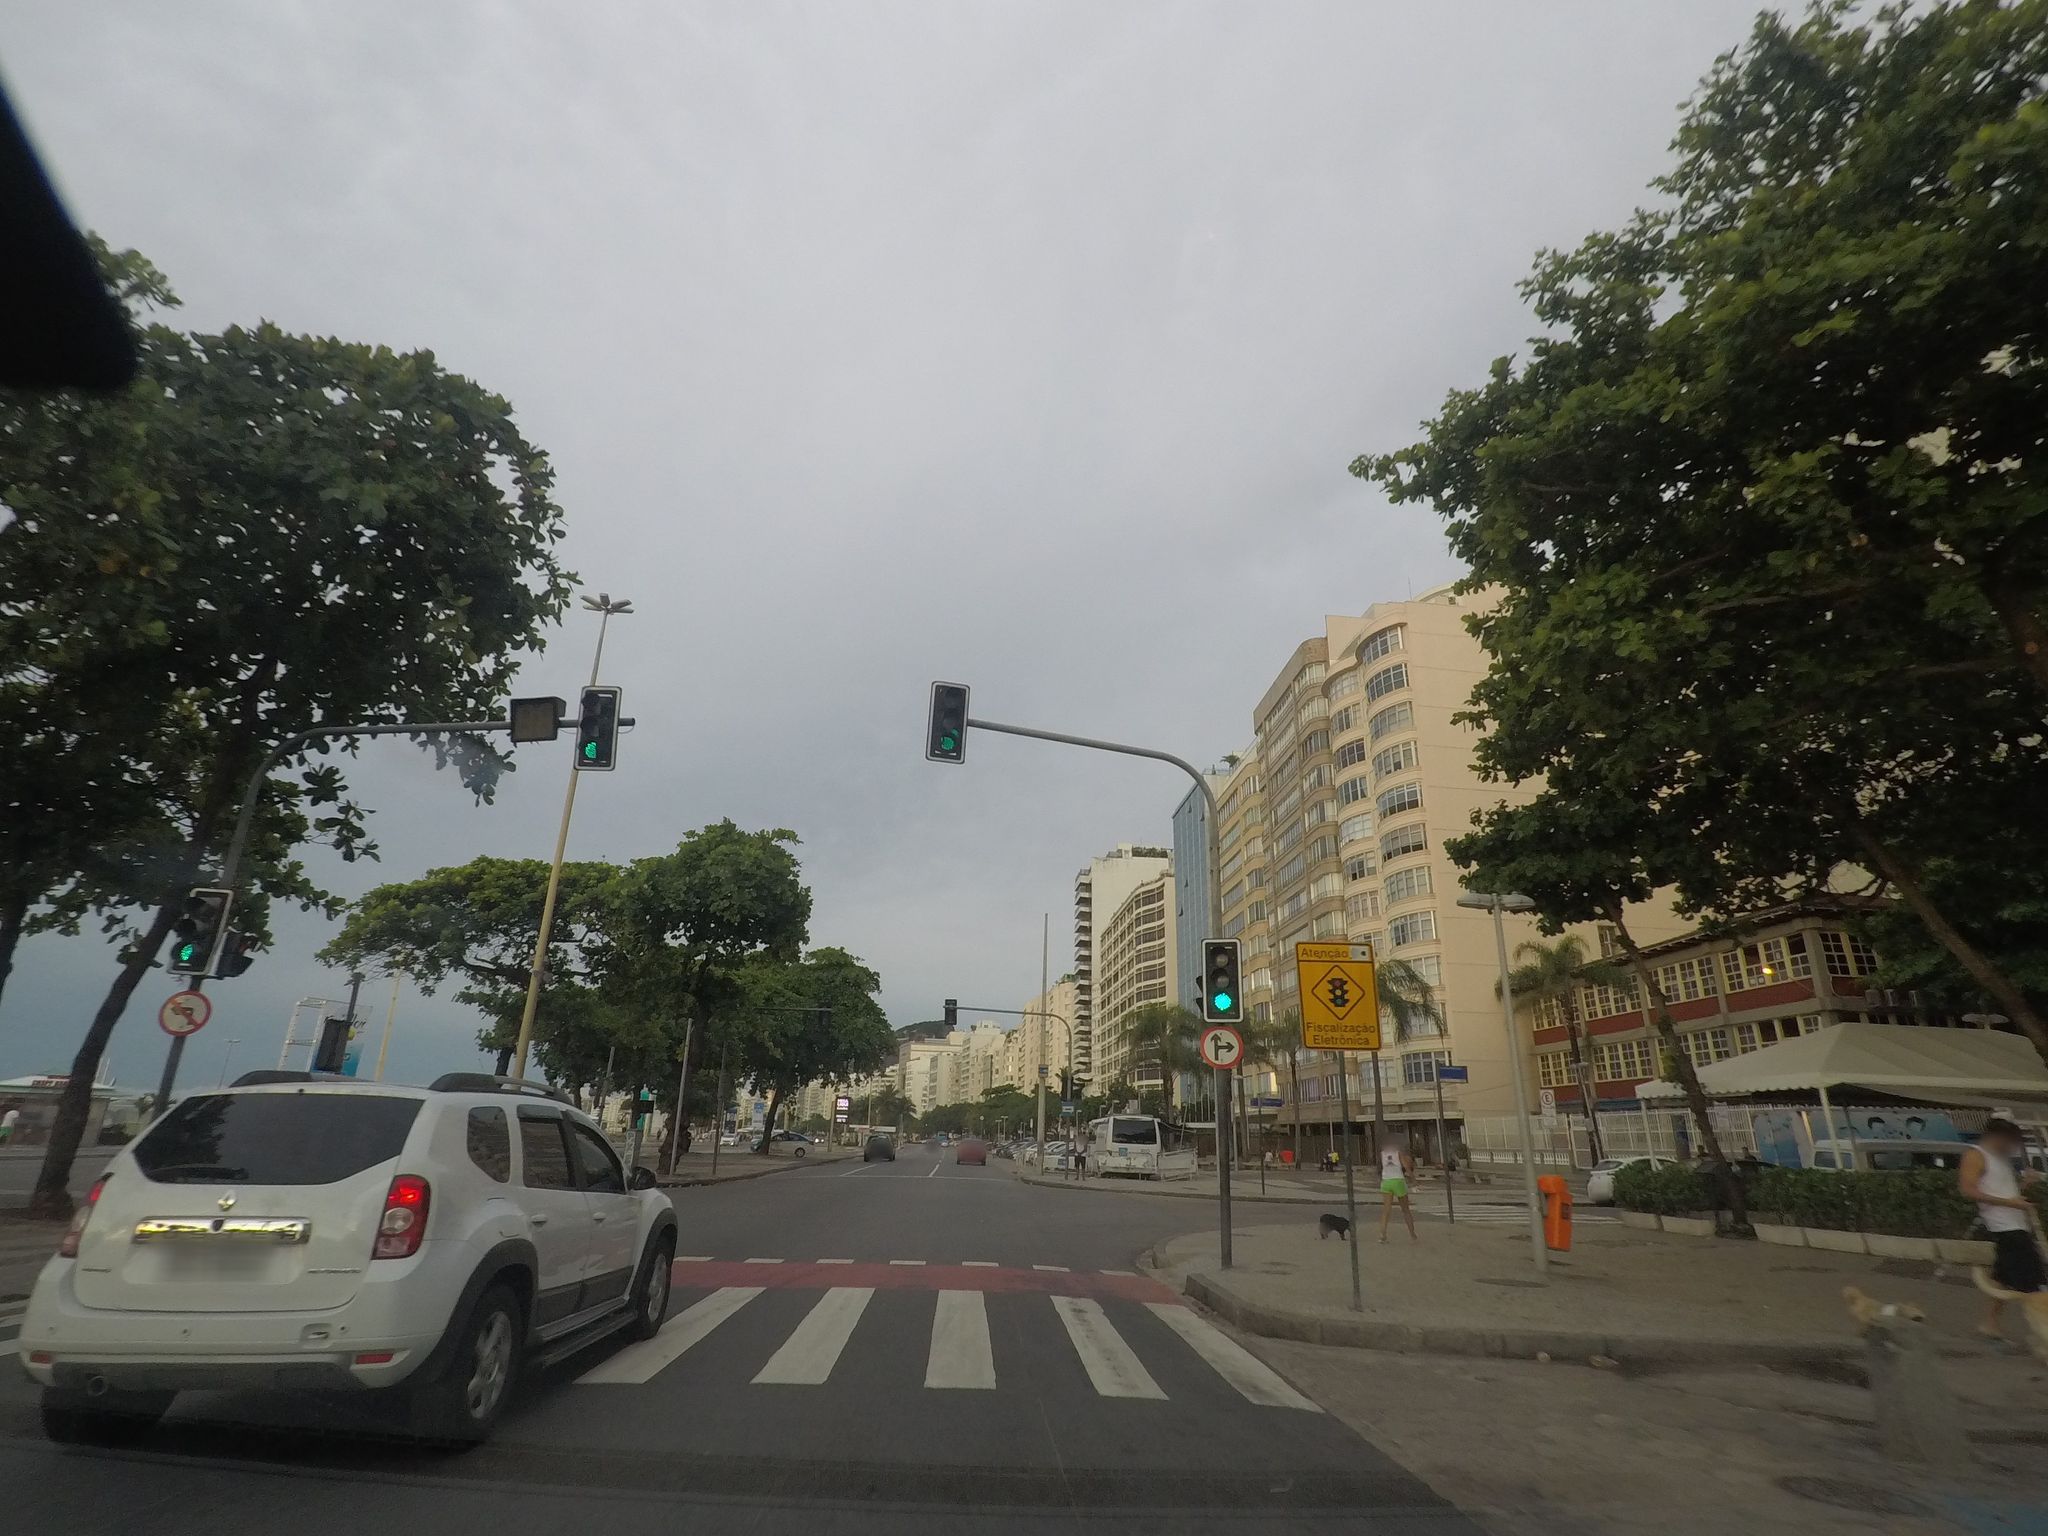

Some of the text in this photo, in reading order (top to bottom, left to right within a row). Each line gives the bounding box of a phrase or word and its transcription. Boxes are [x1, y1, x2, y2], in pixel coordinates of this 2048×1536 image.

[1301, 948, 1348, 959] Atenção
[1306, 1022, 1376, 1035] Fiscalização
[1313, 1034, 1370, 1045] Eletrônica
